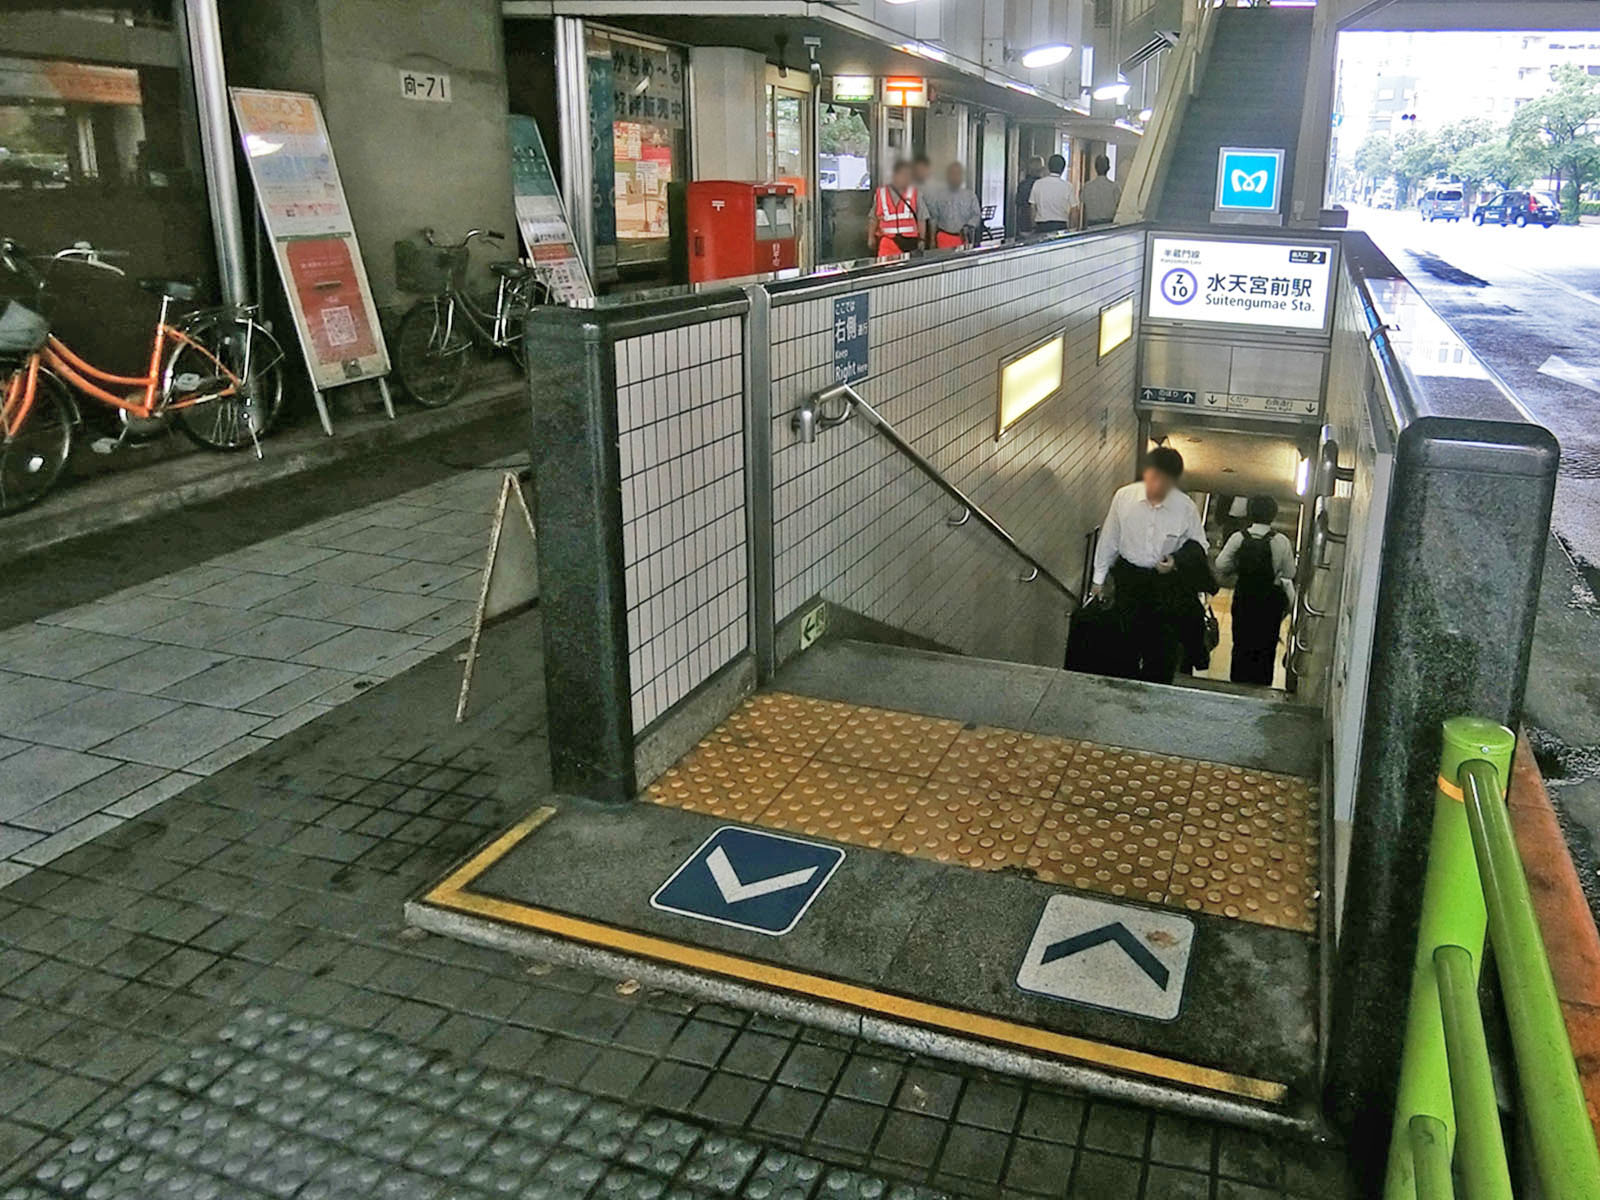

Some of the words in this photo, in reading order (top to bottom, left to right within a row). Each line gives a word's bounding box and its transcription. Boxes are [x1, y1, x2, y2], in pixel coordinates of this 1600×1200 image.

[404, 74, 445, 98] 向-71
[1312, 252, 1321, 263] 2
[1176, 274, 1183, 285] Z
[1207, 273, 1312, 298] 水天宮前駅
[1171, 286, 1188, 298] 10
[1205, 294, 1287, 311] Suitengumae
[1291, 299, 1316, 312] Sta.
[835, 361, 856, 384] Right
